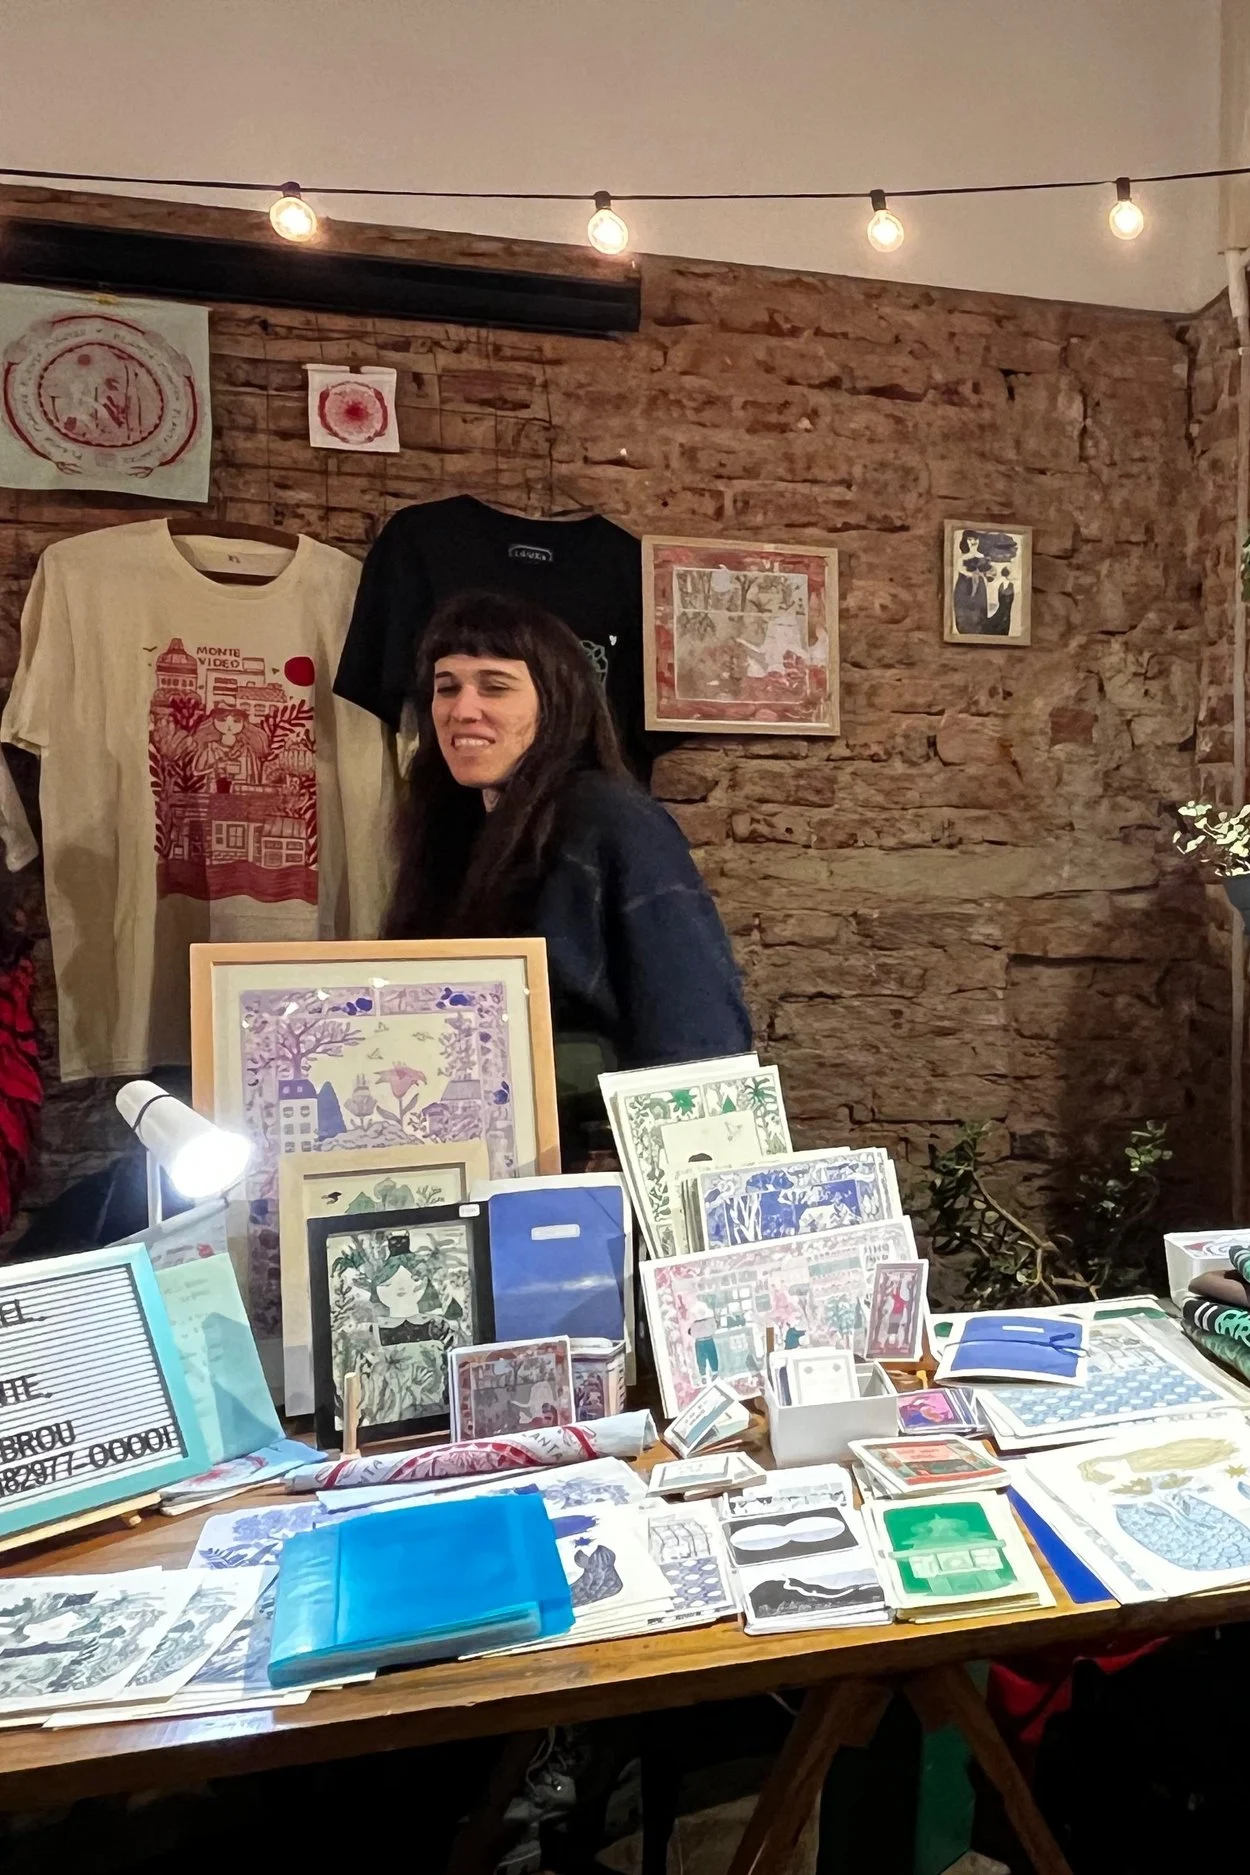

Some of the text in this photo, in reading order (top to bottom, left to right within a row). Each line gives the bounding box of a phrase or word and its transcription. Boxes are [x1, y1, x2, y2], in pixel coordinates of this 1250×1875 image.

[196, 646, 241, 658] MONTE
[198, 657, 240, 668] VIDEO
[0, 1420, 76, 1464] BROU
